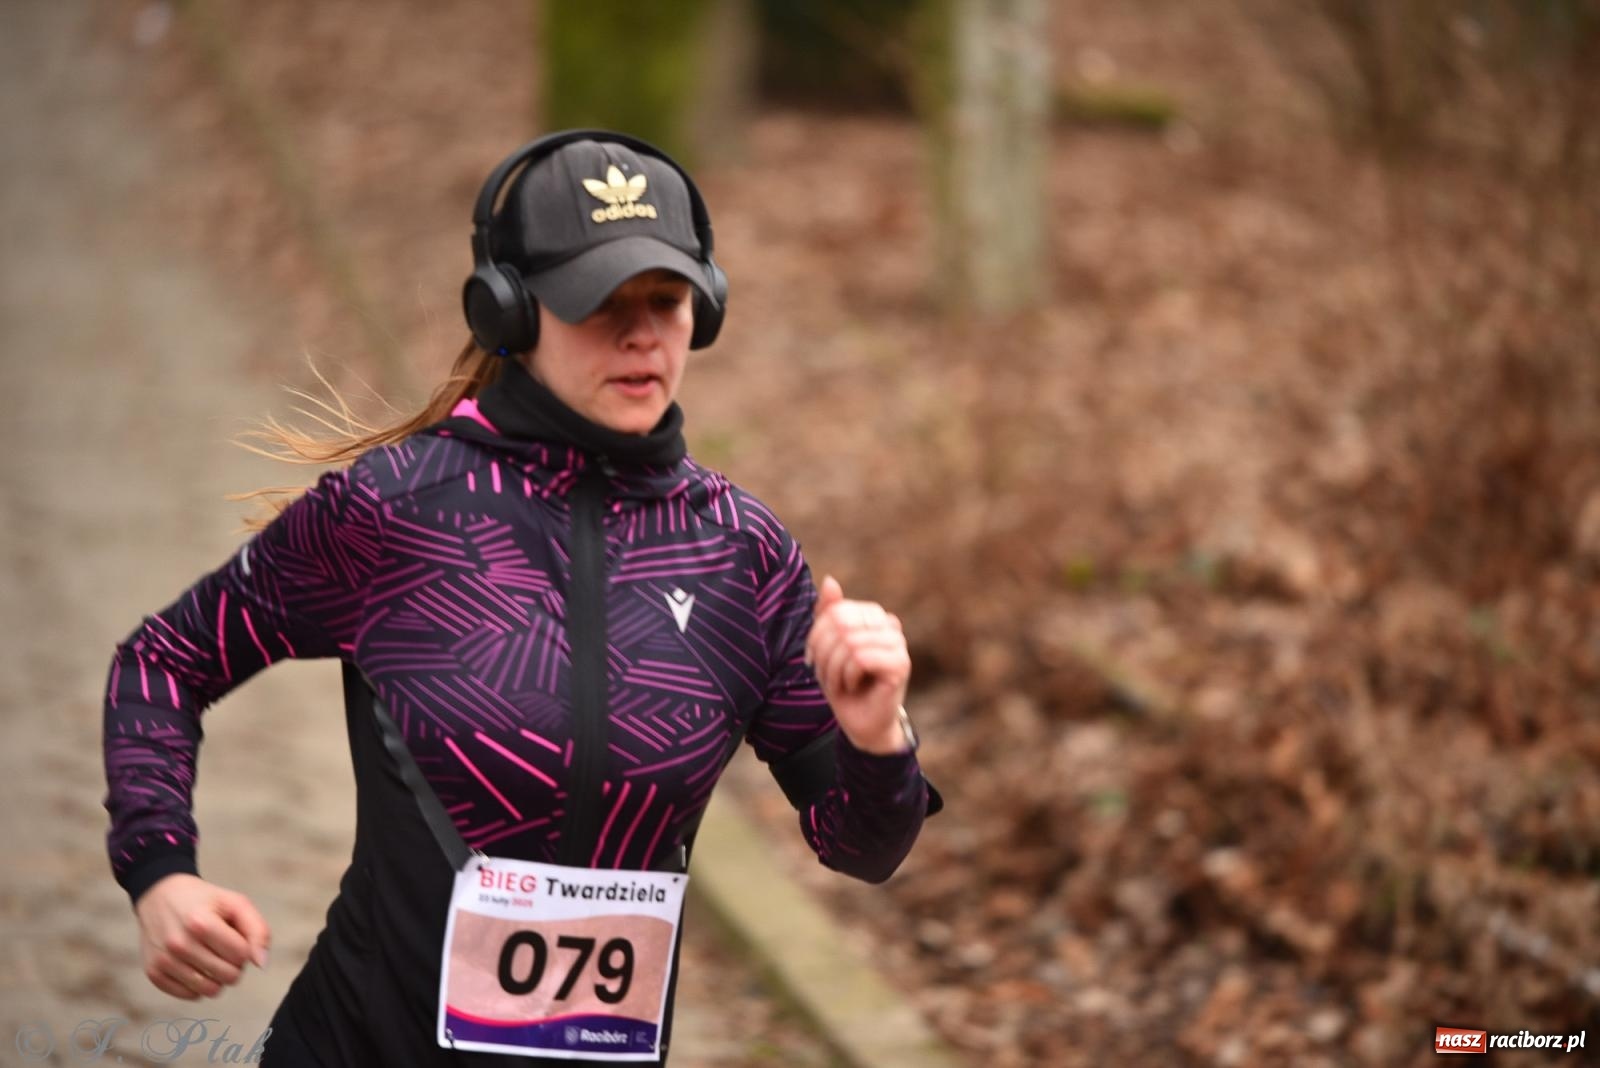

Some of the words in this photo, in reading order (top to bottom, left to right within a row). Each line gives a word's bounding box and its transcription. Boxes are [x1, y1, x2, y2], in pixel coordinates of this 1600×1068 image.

[592, 201, 657, 223] adidas
[480, 869, 537, 893] BIEG
[545, 878, 666, 903] Twardziela
[497, 930, 635, 1004] 079
